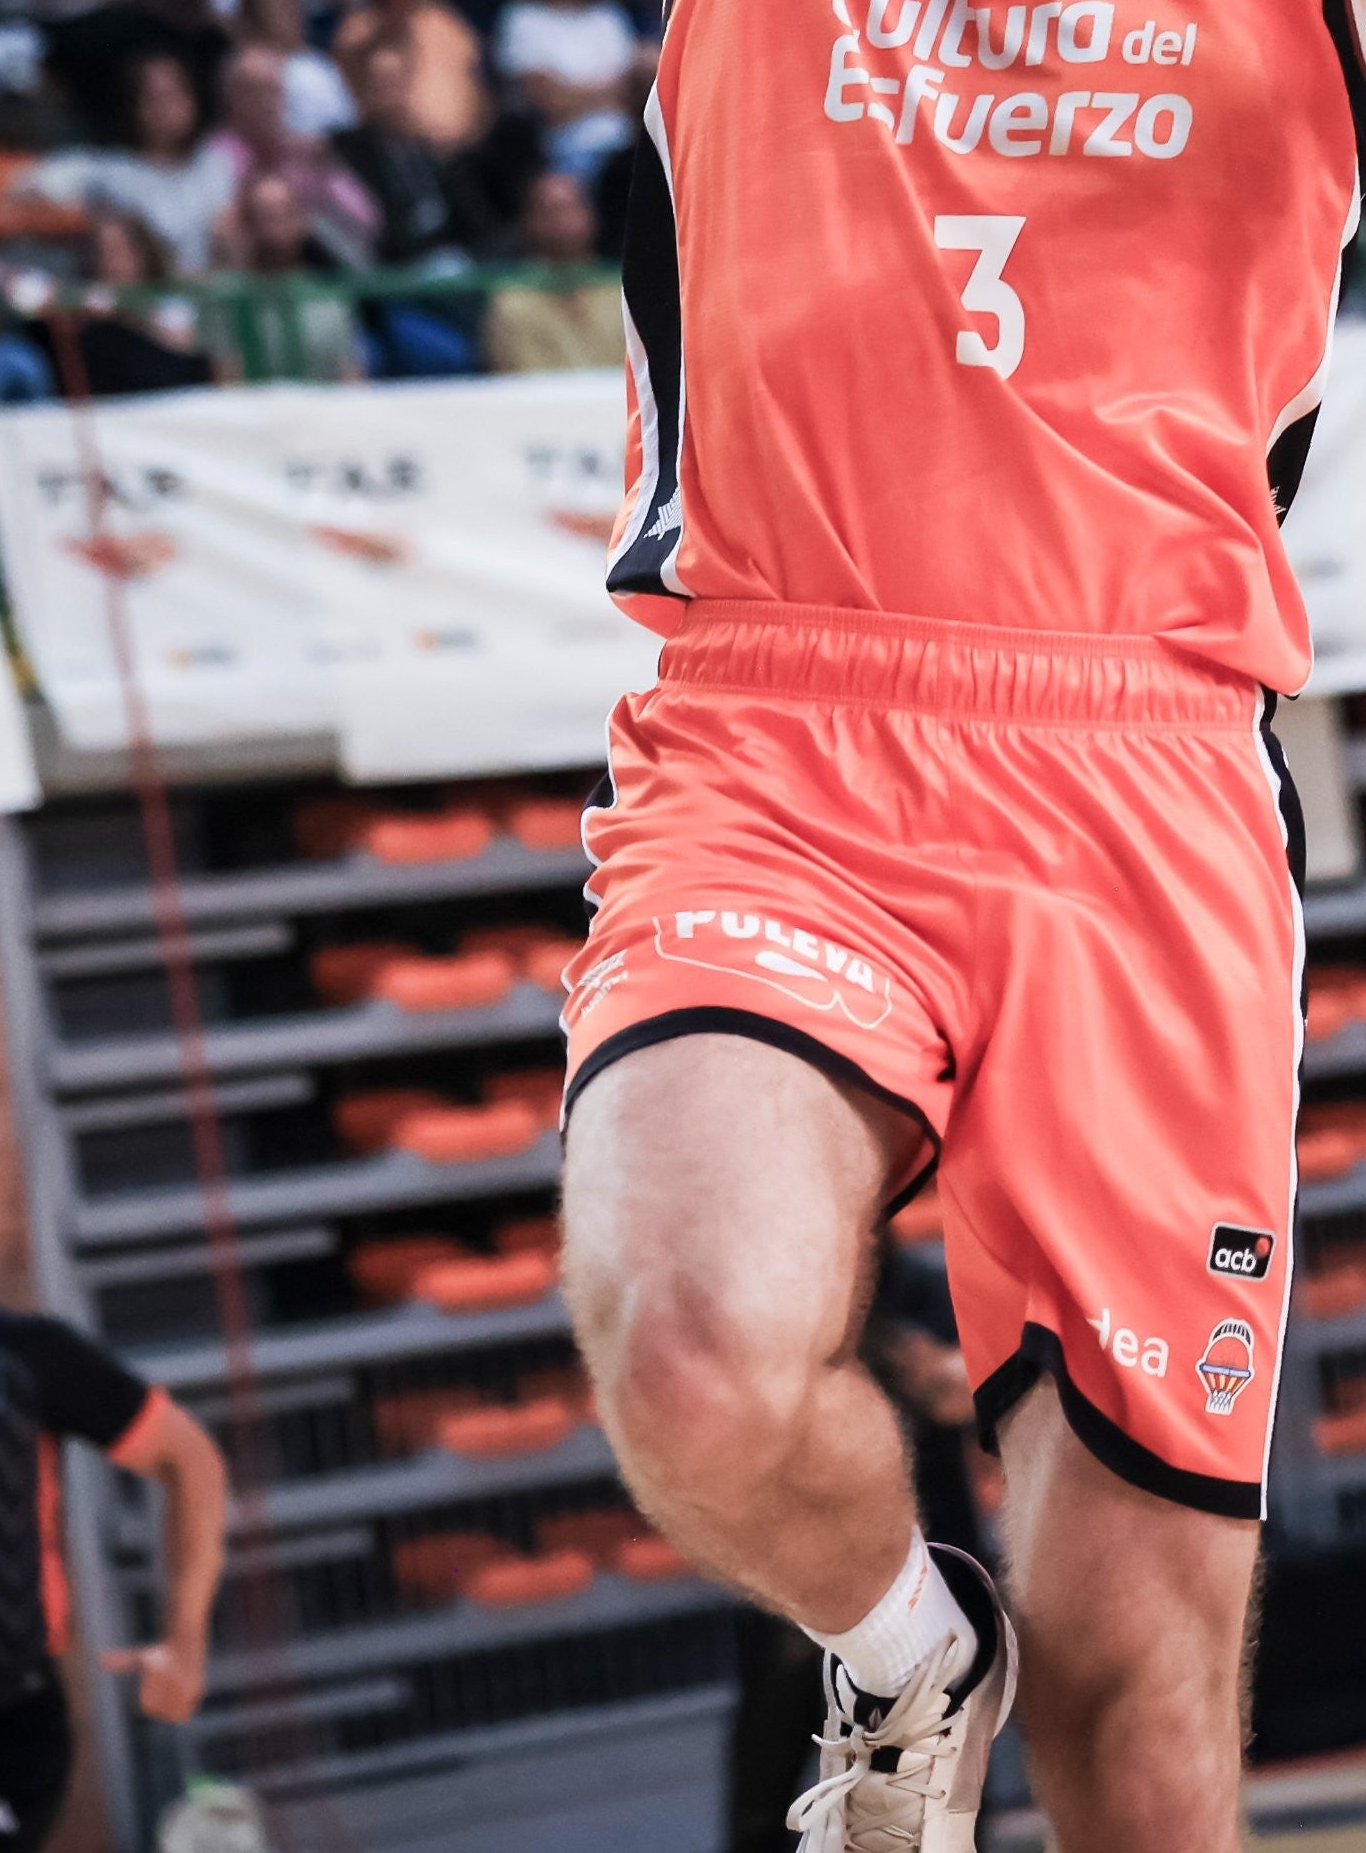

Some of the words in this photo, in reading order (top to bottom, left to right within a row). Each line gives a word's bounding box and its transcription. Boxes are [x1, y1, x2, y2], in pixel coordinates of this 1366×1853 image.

[1122, 20, 1198, 66] del
[934, 214, 1027, 381] 3
[1214, 1248, 1257, 1273] acb
